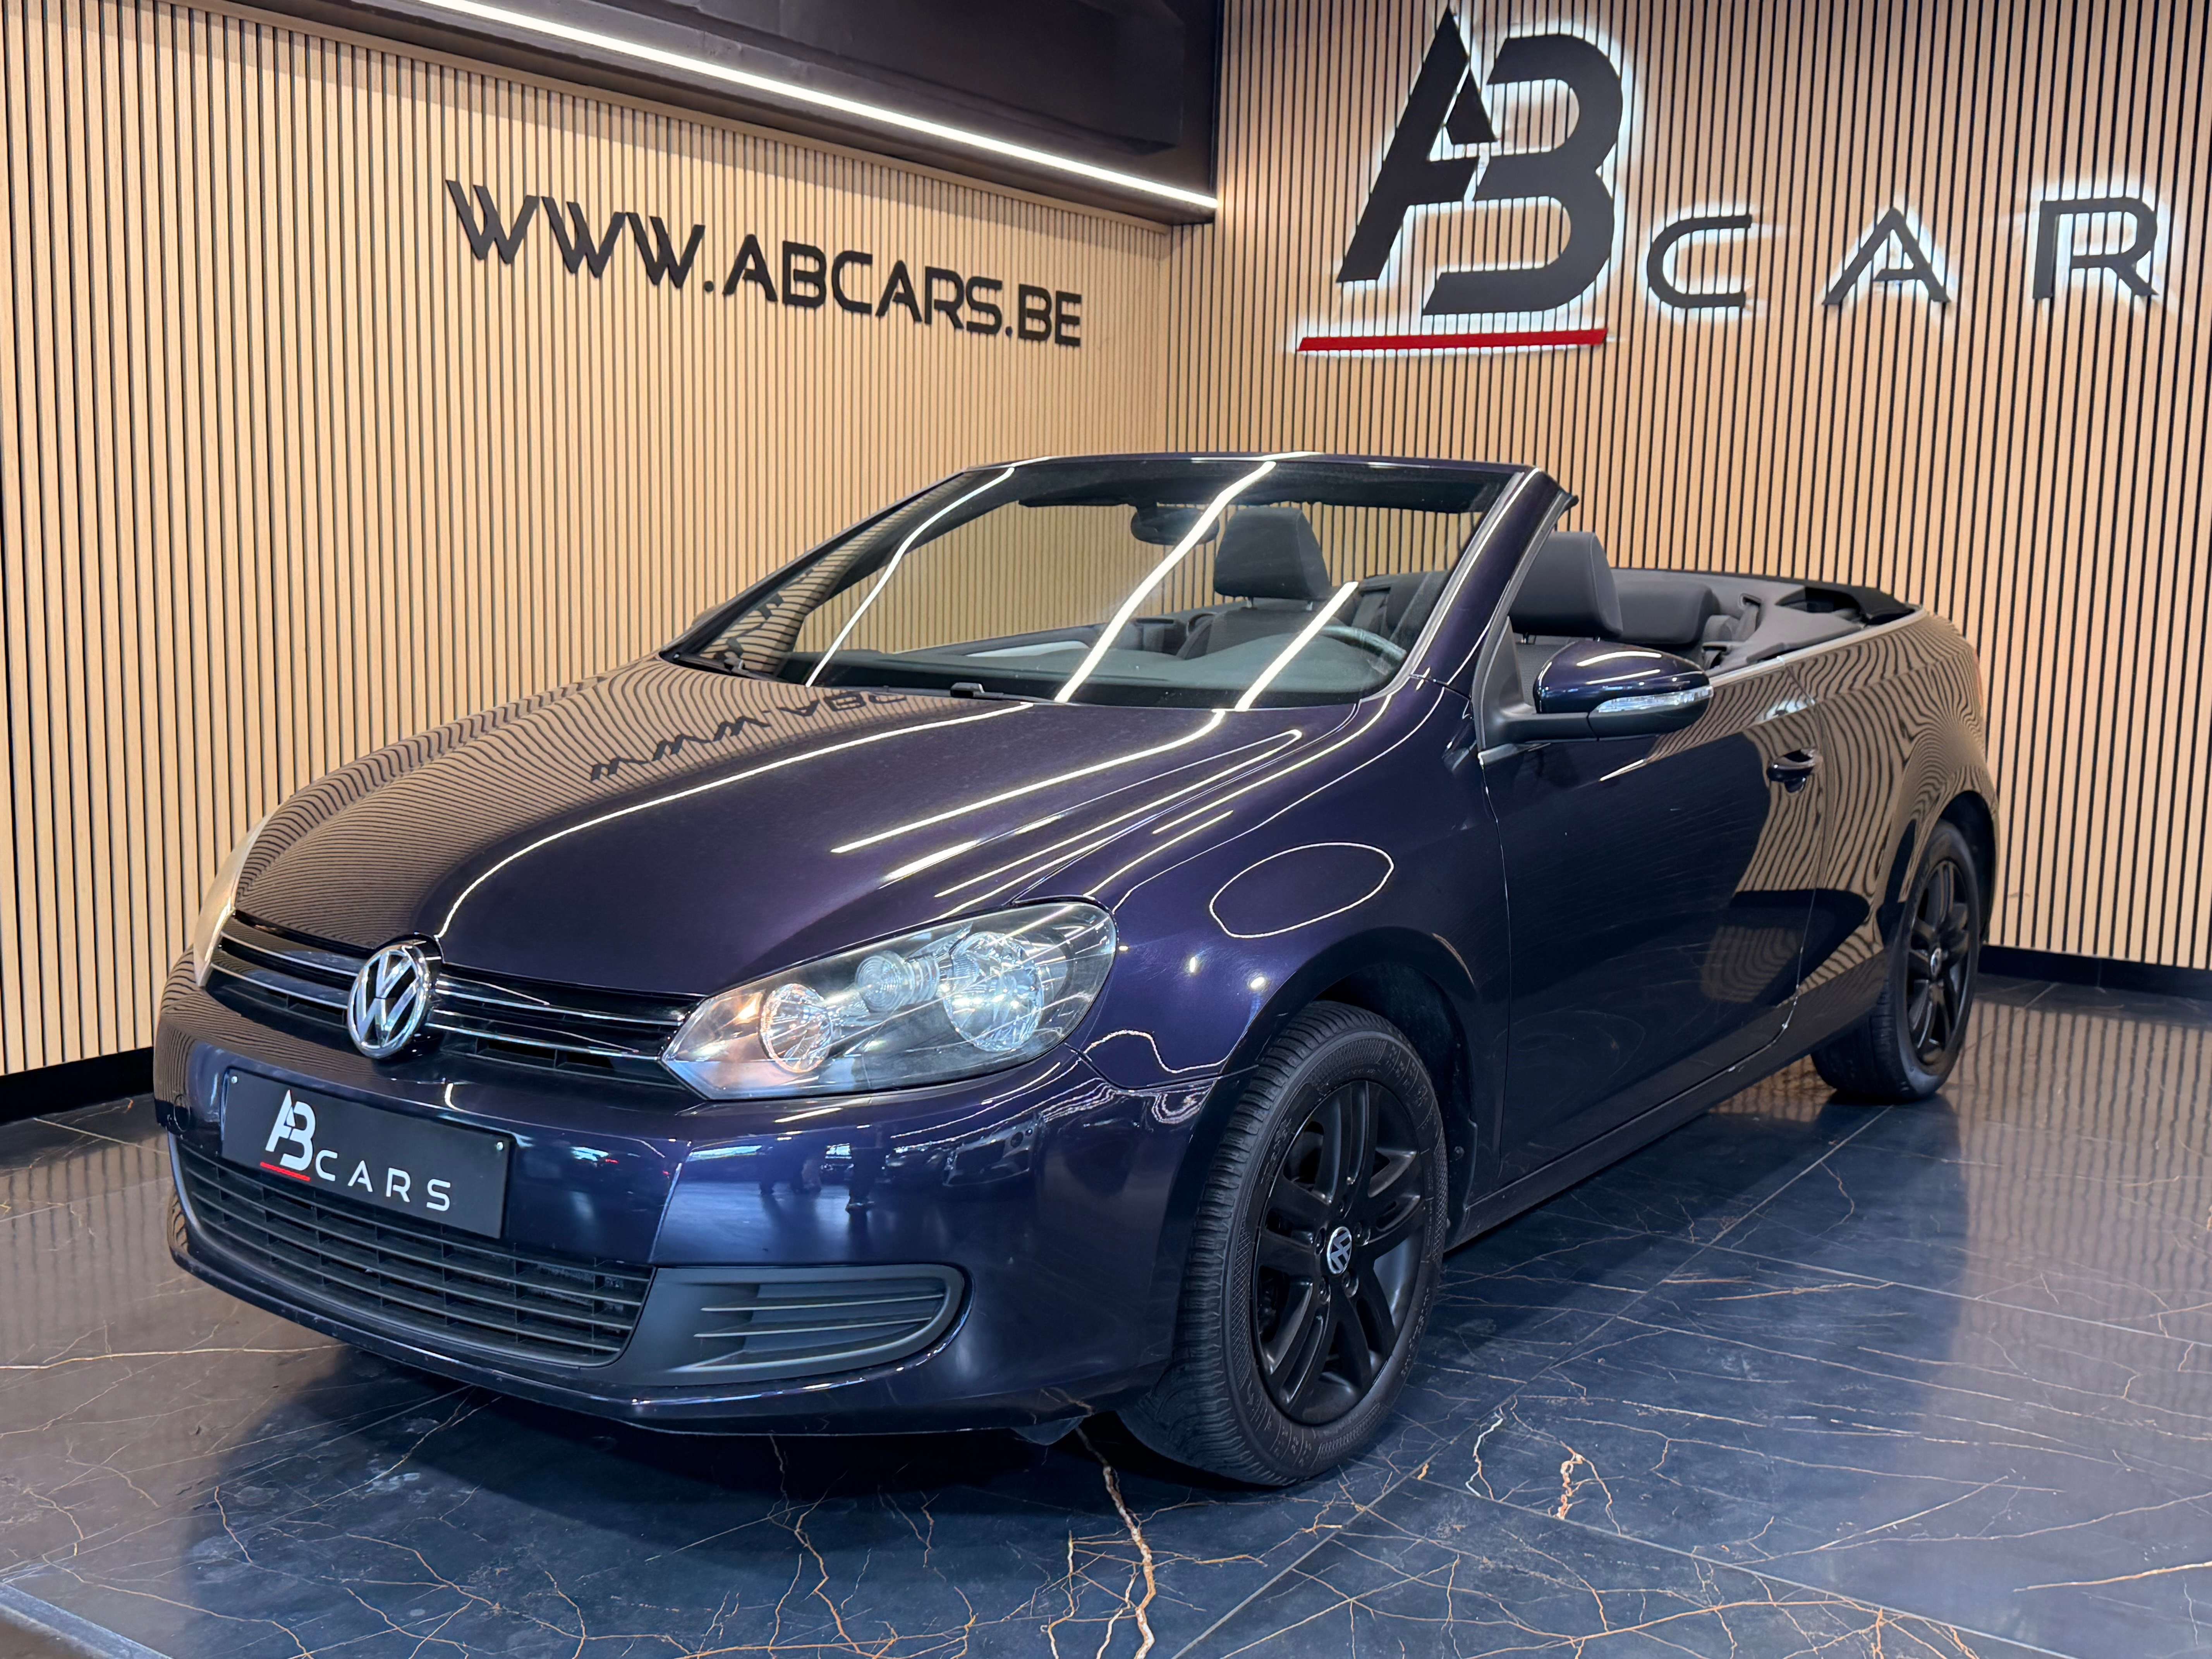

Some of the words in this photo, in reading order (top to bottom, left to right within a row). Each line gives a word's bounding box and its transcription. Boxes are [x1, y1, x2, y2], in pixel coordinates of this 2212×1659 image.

[445, 180, 1082, 347] WWW.ABCARS.BE
[1647, 197, 2159, 308] CAR
[265, 1089, 316, 1171] AB
[315, 1150, 451, 1211] CARS
